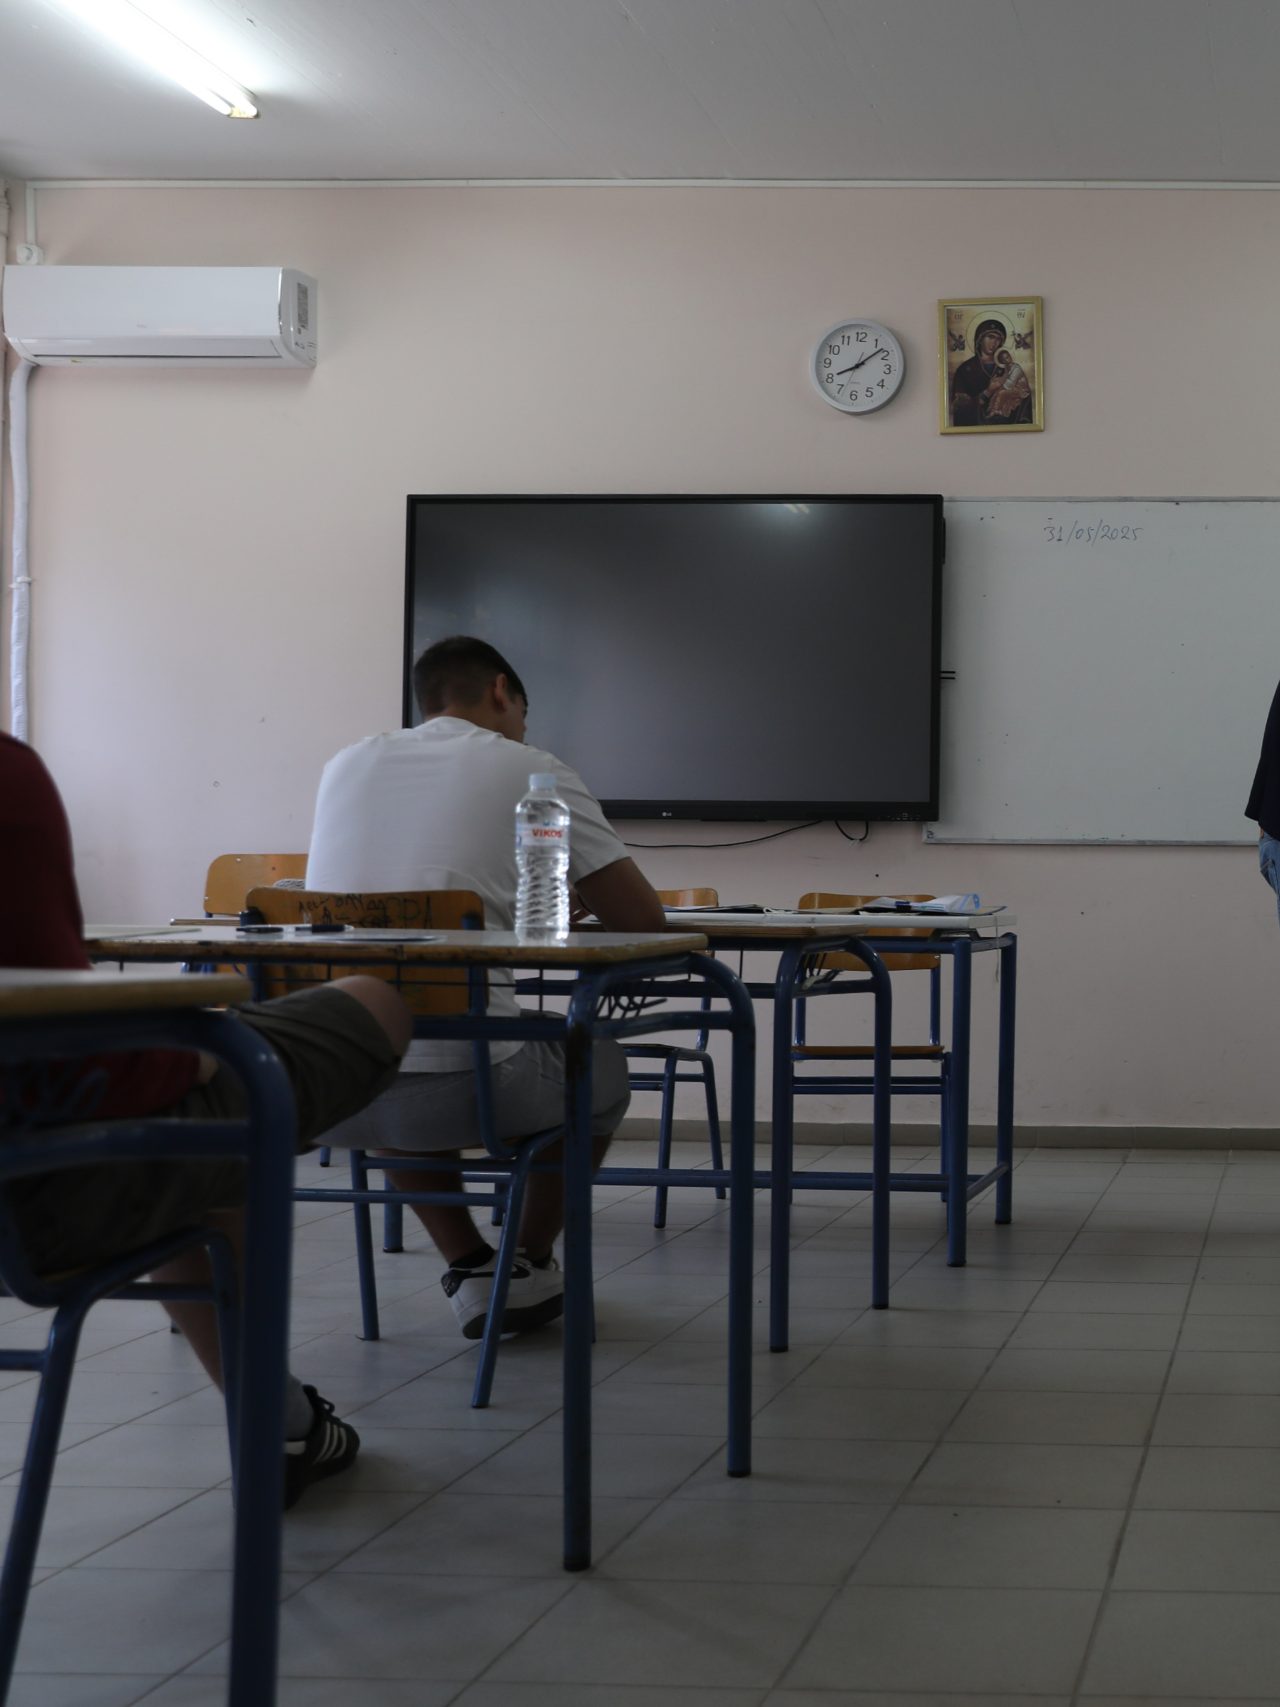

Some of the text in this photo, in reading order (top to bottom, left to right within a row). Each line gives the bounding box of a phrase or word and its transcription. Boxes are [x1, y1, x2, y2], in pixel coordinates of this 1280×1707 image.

[841, 335, 851, 346] 11
[855, 331, 868, 343] 12
[828, 344, 840, 355] 10
[880, 349, 890, 361] 2
[823, 357, 832, 368] 9
[883, 364, 892, 375] 3
[825, 373, 834, 384] 8
[876, 378, 885, 389] 4
[836, 383, 845, 395] 7
[865, 386, 874, 398] 5
[849, 390, 858, 401] 6
[1043, 519, 1145, 547] 31/05/2025
[532, 828, 563, 838] VIKOS
